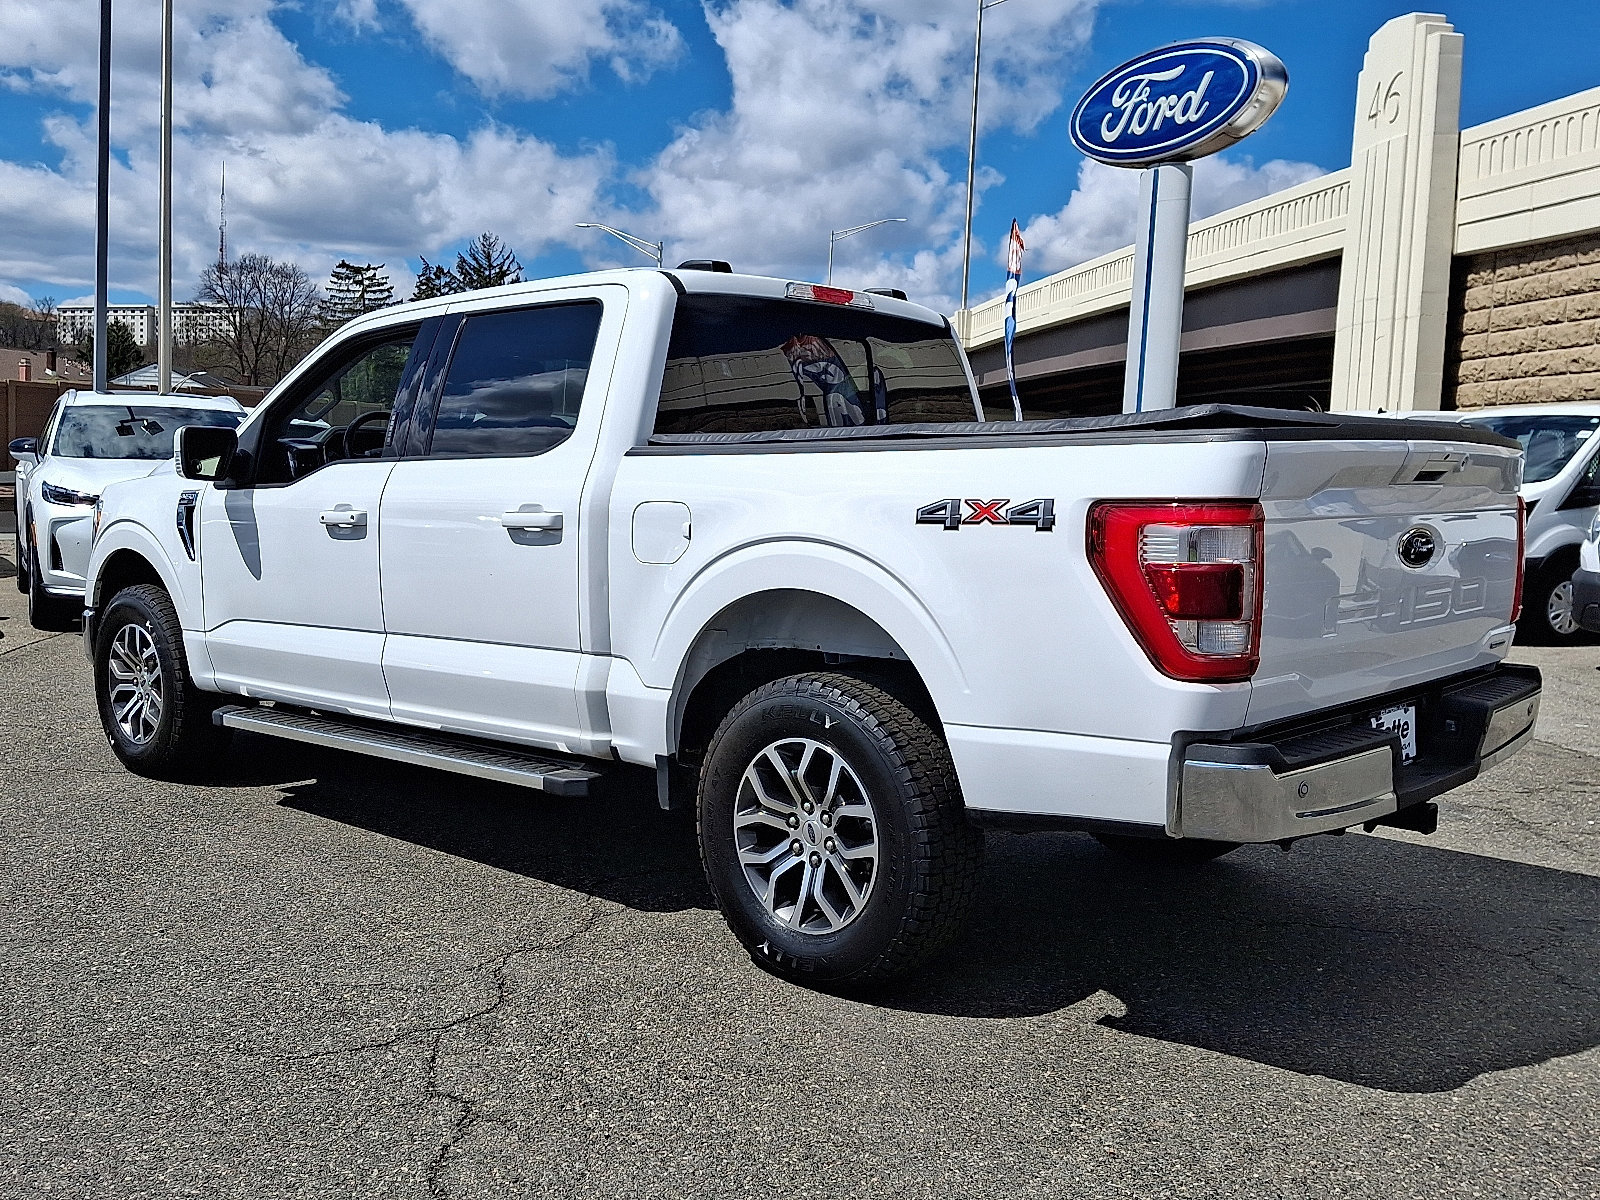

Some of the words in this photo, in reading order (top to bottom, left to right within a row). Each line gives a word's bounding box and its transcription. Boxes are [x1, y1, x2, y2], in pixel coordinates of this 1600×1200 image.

[1101, 64, 1215, 142] Ford
[1368, 71, 1403, 129] 46
[761, 704, 840, 729] KELLY
